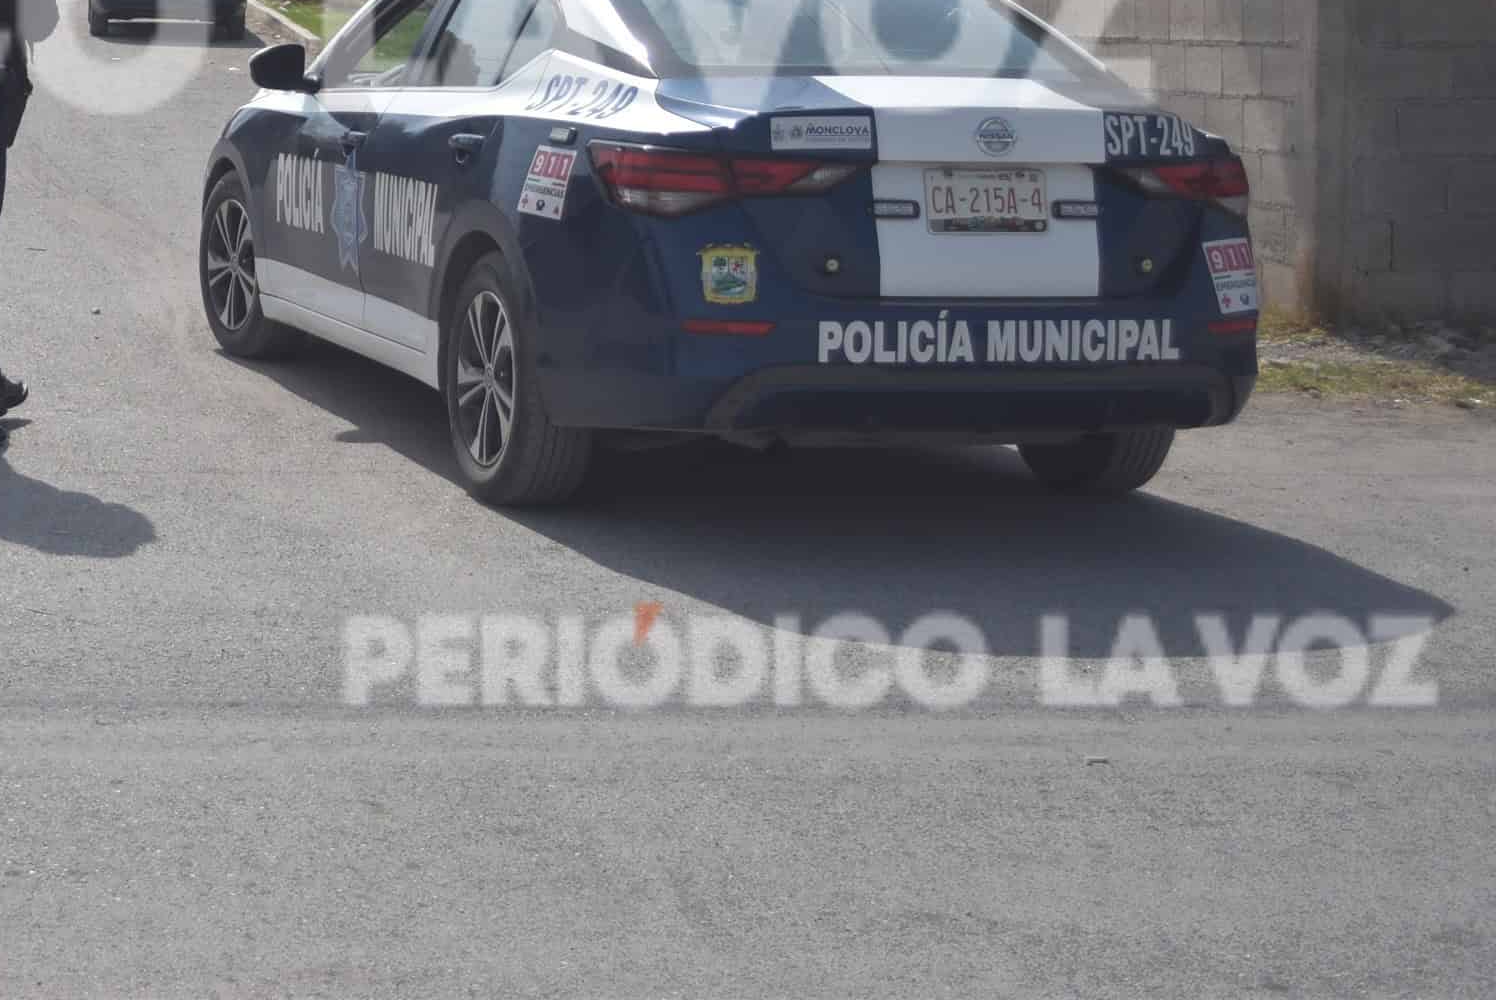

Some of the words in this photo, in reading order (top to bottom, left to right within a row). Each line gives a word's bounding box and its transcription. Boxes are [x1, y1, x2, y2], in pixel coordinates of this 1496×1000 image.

[525, 74, 639, 119] SPT-249
[1105, 115, 1195, 156] SPT-249
[532, 153, 569, 181] 911
[277, 148, 325, 233] POLICÍA
[373, 171, 438, 268] MUNICIPAL
[931, 186, 1043, 214] CA-215A-4
[1210, 243, 1253, 270] 911
[818, 310, 975, 363] POLICÍA
[987, 319, 1181, 362] MUNICIPAL
